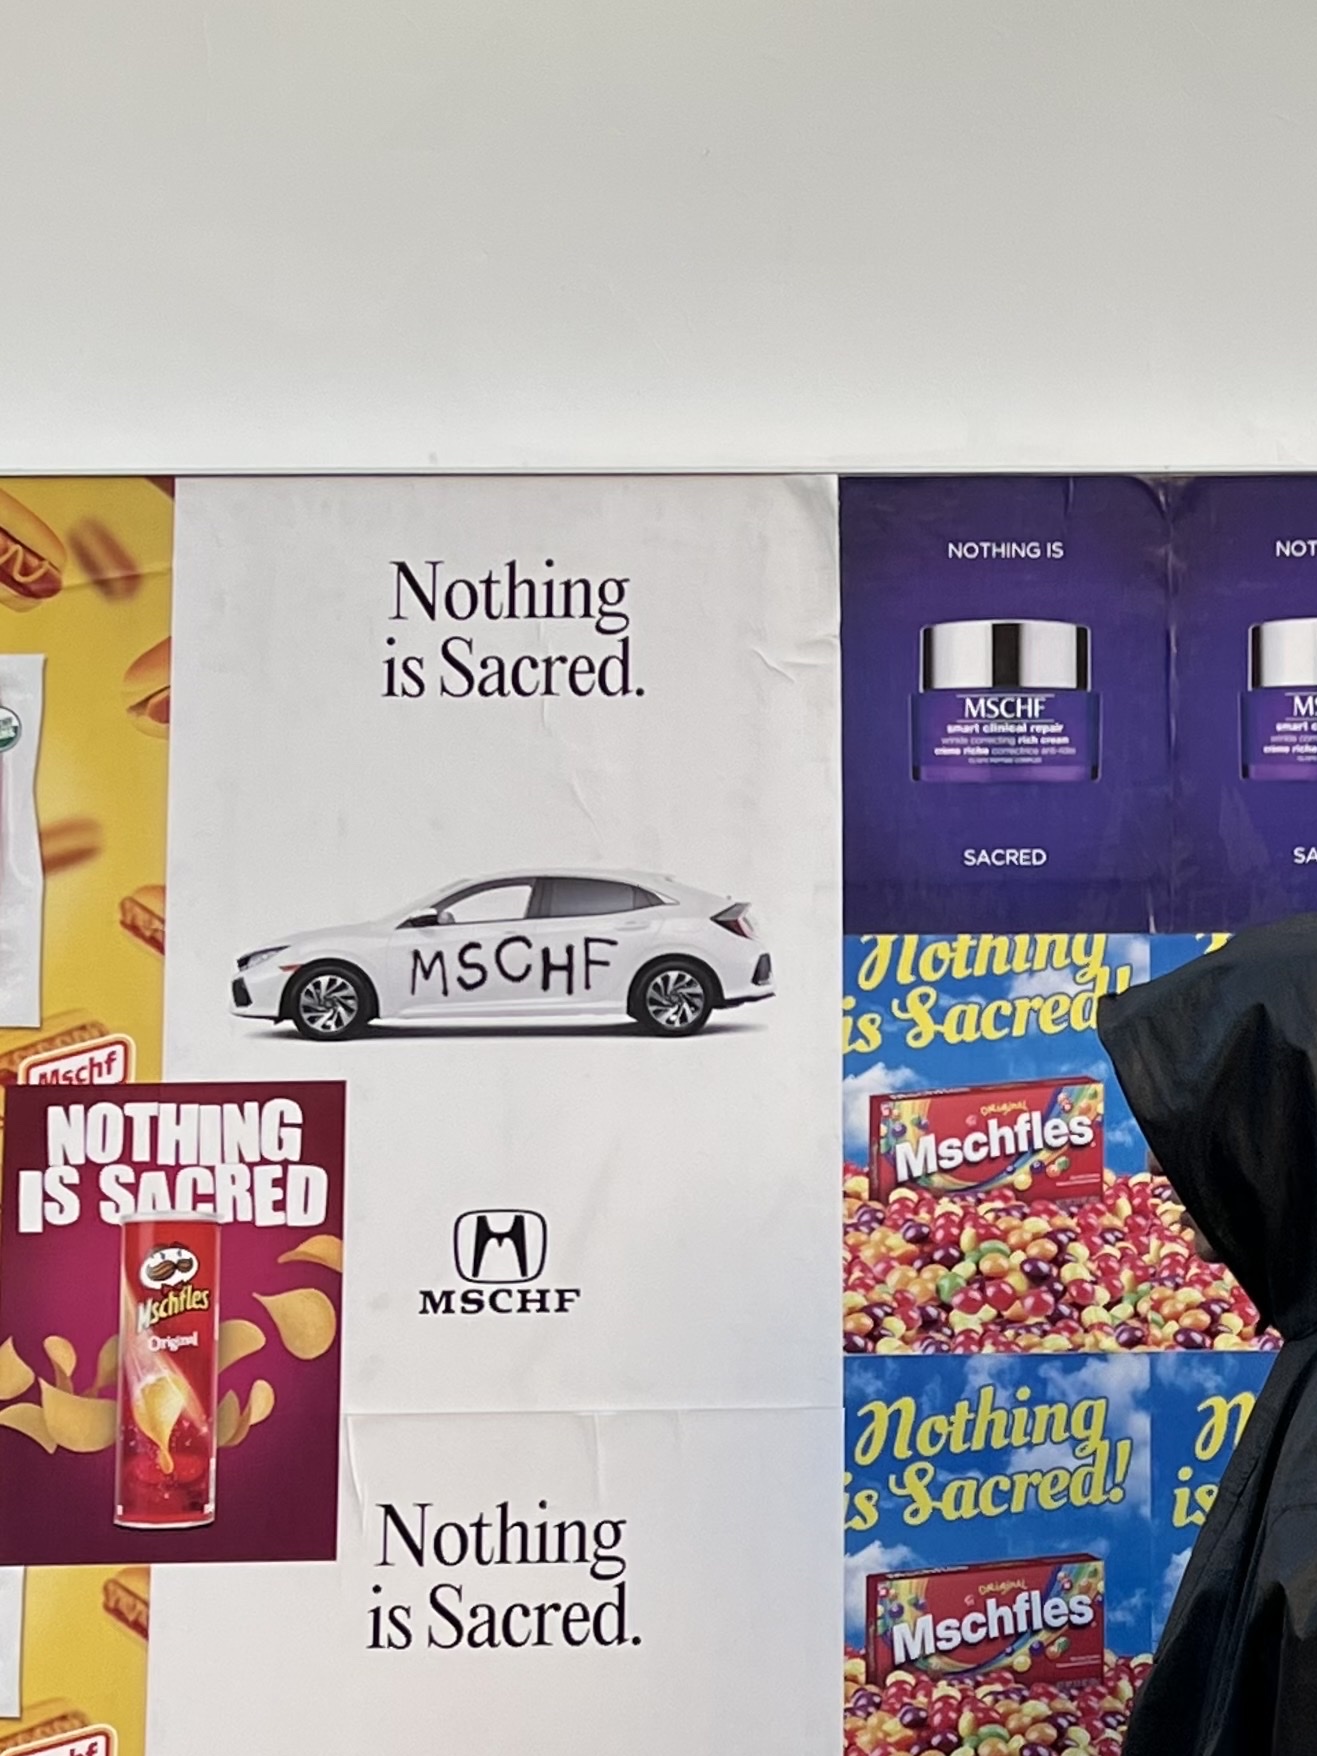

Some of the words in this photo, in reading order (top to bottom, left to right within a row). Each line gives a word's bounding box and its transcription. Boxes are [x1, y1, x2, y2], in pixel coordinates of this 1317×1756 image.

[948, 542, 1041, 559] NOTHING
[1046, 542, 1064, 558] IS
[391, 559, 630, 635] Nothing
[382, 636, 426, 698] is
[440, 636, 646, 698] Sacred.
[947, 724, 979, 733] smart
[983, 723, 1026, 733] clinical
[1030, 724, 1064, 735] repair
[964, 698, 1046, 718] MSCHF
[1276, 721, 1308, 732] smart
[963, 848, 1047, 866] SACRED
[411, 936, 618, 996] MSCHF
[857, 934, 1107, 991] Nothing
[842, 996, 883, 1054] is
[47, 1098, 303, 1166] NOTHING
[896, 1112, 1094, 1183] Mschfles
[18, 1166, 80, 1233] IS
[99, 1163, 328, 1227] SACRED
[136, 1285, 210, 1334] Mschfles
[419, 1288, 580, 1314] MSCHF
[148, 1331, 198, 1352] Original
[853, 1385, 1109, 1467] Nothing
[888, 1439, 1134, 1526] Sacred!
[1171, 1466, 1219, 1528] is
[374, 1499, 627, 1581] Nothing
[366, 1585, 413, 1650] is
[428, 1582, 642, 1649] Sacred.
[892, 1591, 1094, 1667] Mschfles
